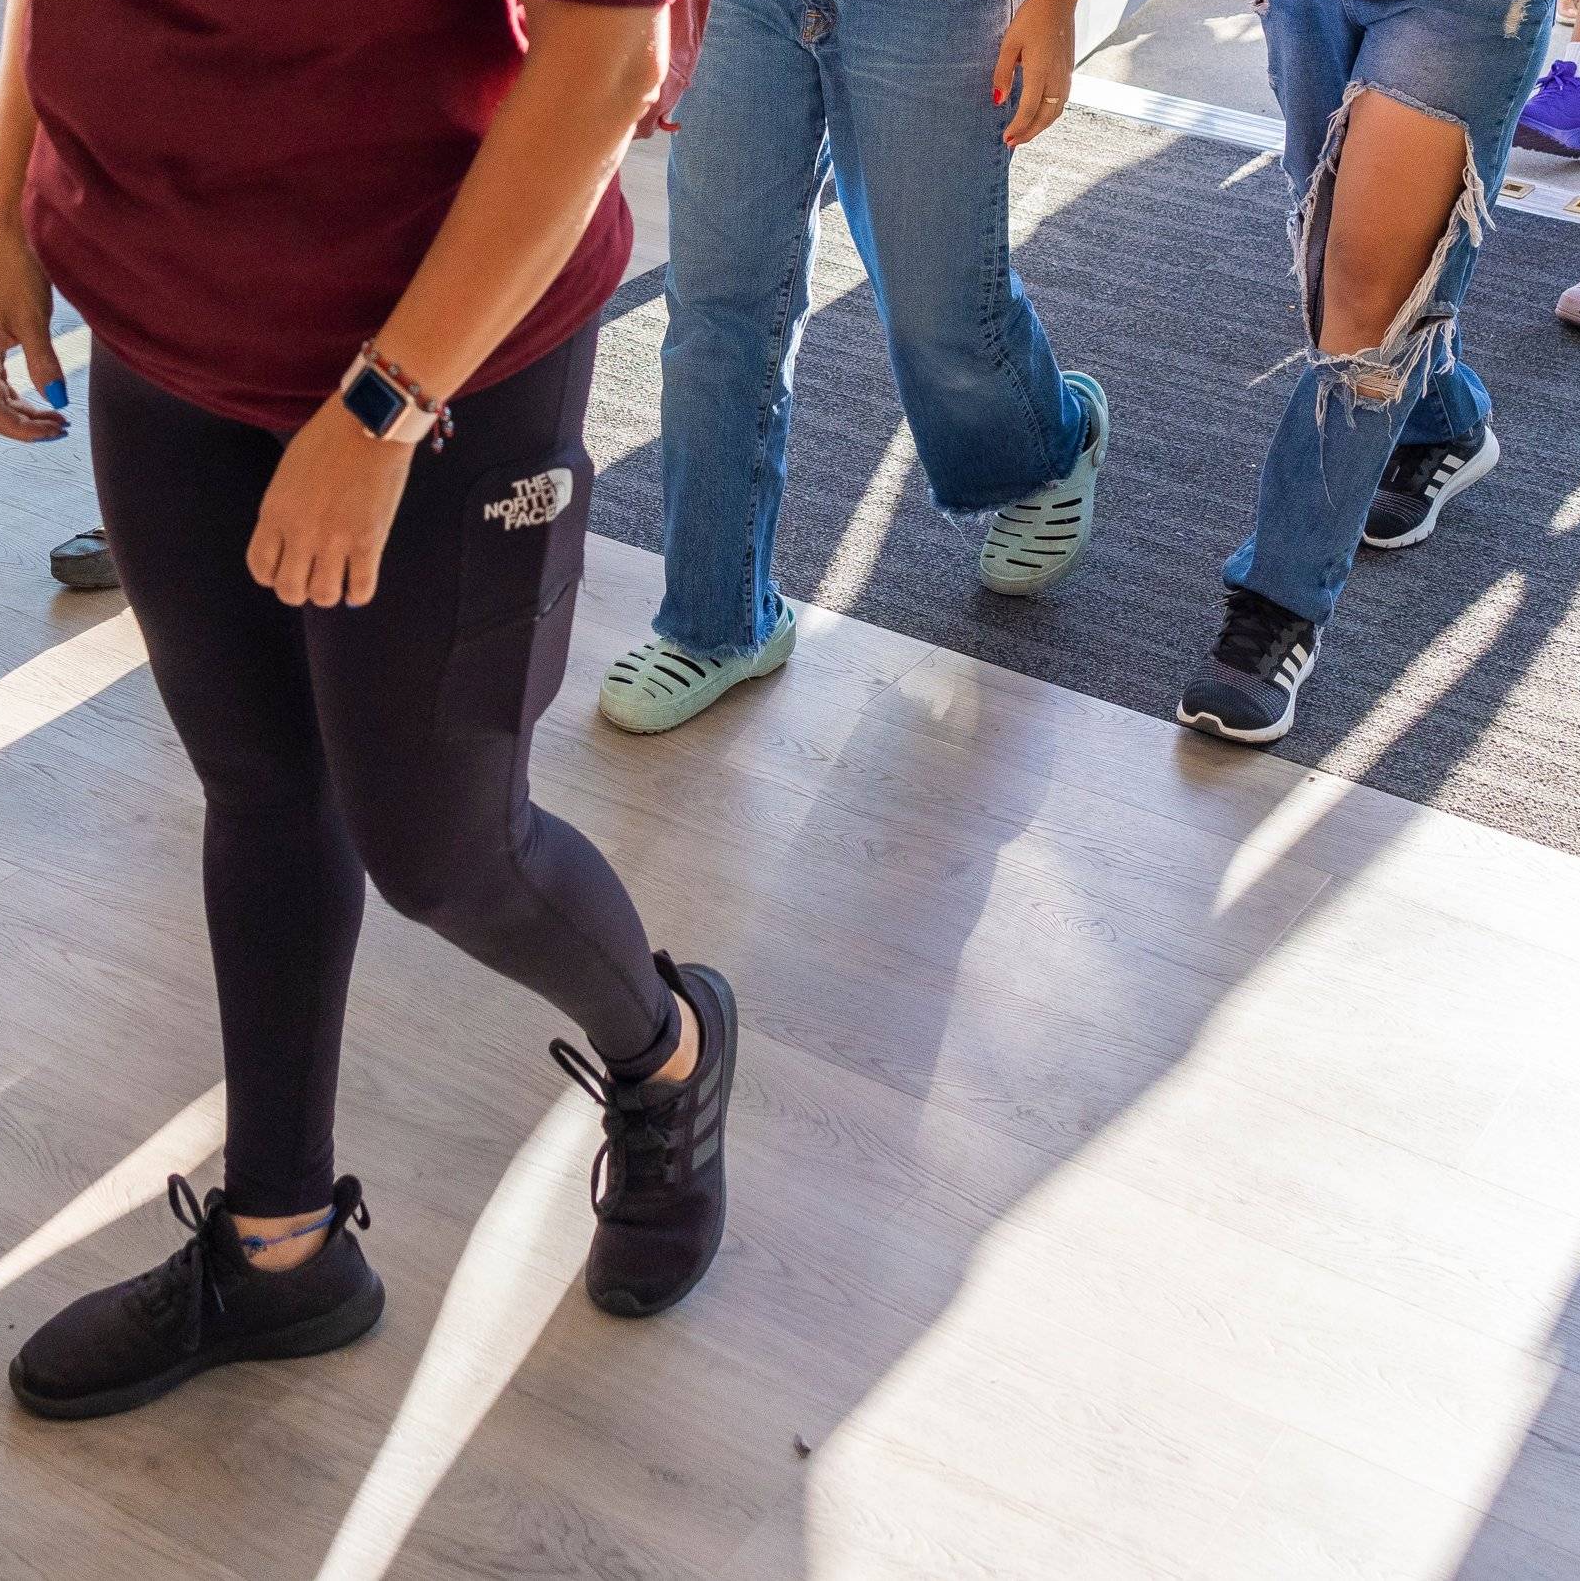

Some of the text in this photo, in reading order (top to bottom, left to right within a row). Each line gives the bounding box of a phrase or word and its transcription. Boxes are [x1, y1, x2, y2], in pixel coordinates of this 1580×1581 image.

[511, 471, 551, 498] THE
[483, 485, 557, 522] NORTH
[503, 504, 557, 532] FACE
